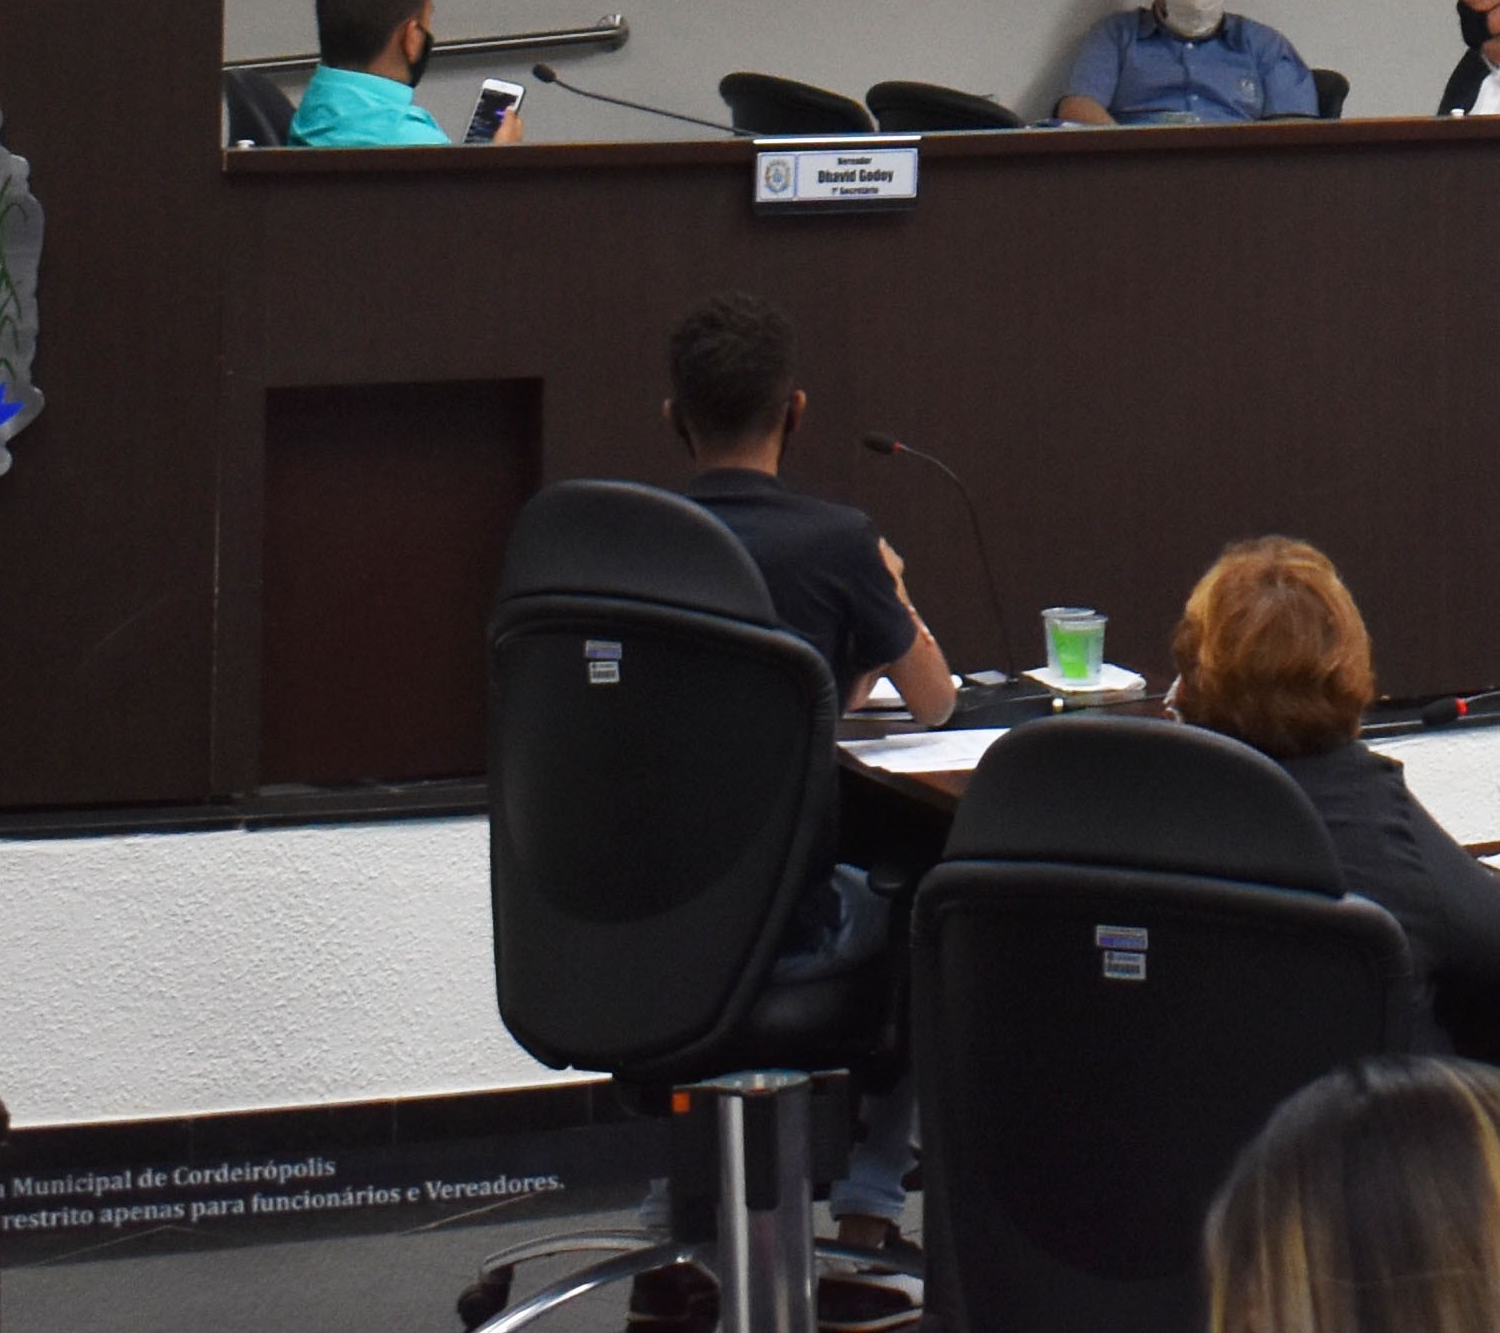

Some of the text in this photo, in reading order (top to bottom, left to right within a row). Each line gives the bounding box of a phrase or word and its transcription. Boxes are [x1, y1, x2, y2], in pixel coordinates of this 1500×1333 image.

[859, 168, 895, 184] Godoy
[12, 1168, 132, 1197] Municipal
[137, 1167, 167, 1189] de
[173, 1156, 337, 1185] Cordeirópolis
[1, 1206, 95, 1231] restrito
[100, 1200, 186, 1228] apenas
[190, 1195, 245, 1222] para
[251, 1184, 401, 1214] funcionários
[407, 1186, 421, 1203] e
[424, 1173, 565, 1201] Vereadores.
